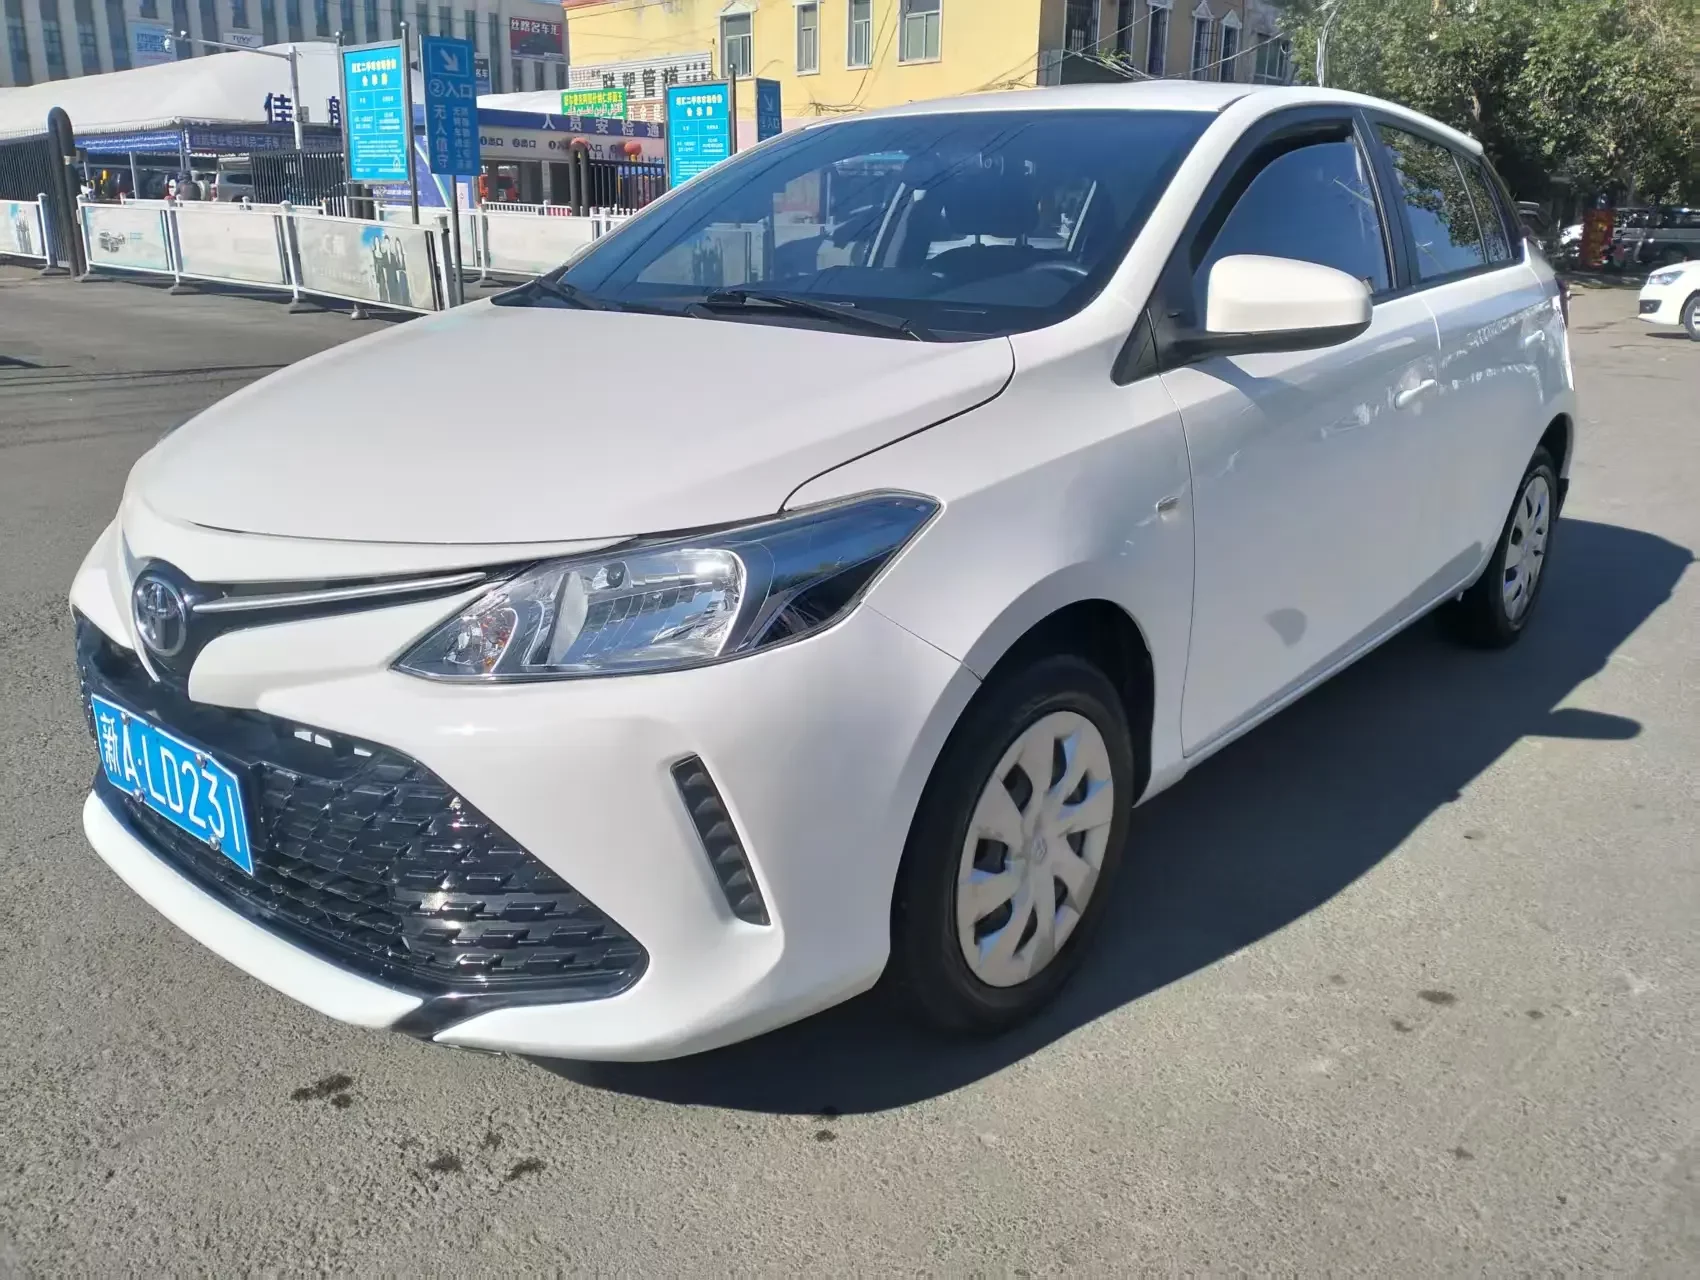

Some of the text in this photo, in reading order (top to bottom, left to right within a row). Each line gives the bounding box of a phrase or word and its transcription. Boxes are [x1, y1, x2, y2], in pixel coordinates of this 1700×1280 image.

[511, 19, 560, 36] 丝路名车汇
